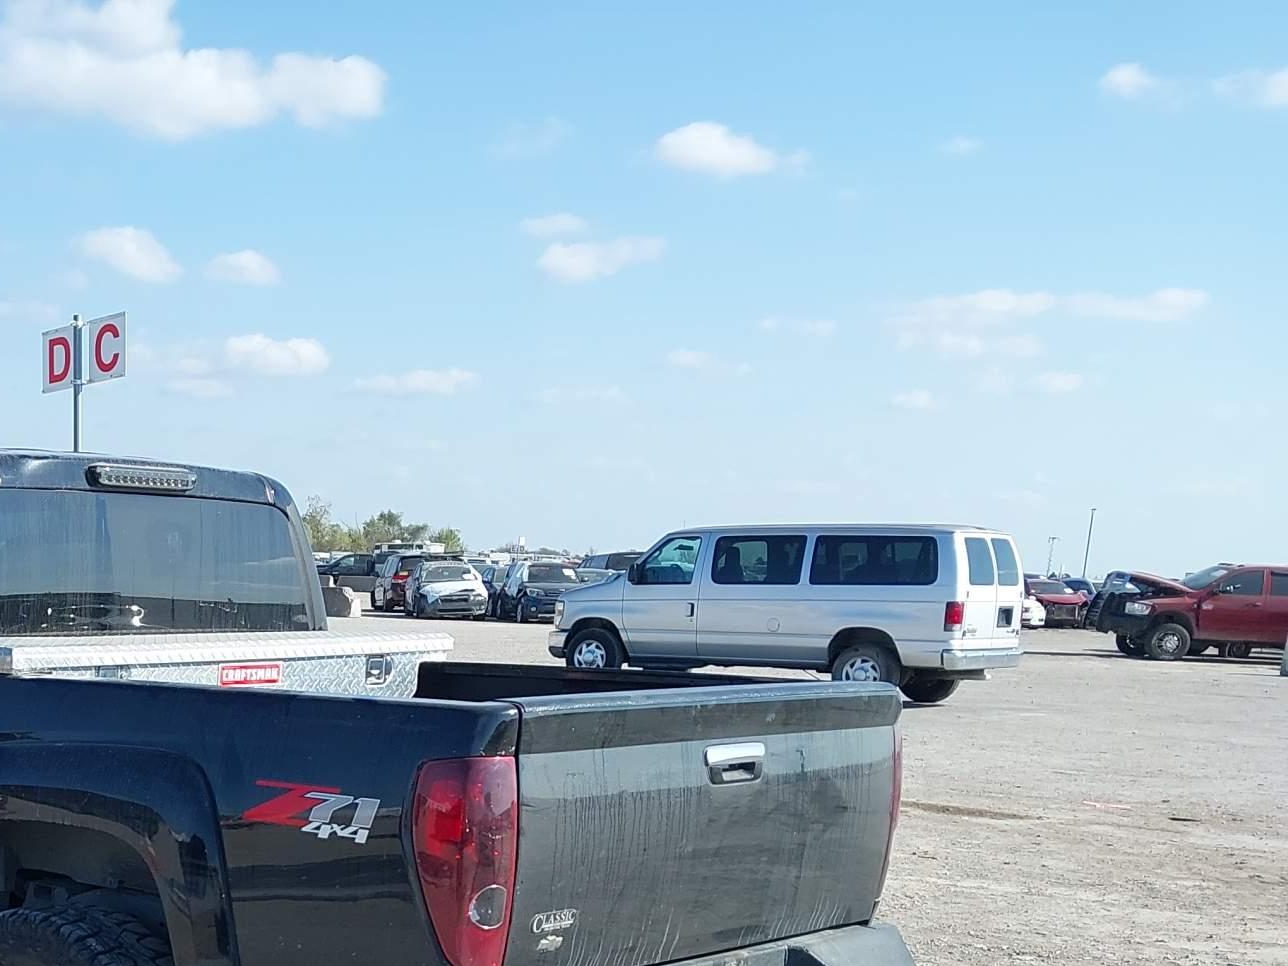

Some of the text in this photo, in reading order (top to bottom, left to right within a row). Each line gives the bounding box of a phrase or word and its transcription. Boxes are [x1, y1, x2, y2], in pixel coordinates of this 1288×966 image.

[48, 336, 71, 384] D
[95, 323, 120, 373] C
[222, 666, 280, 682] CRAFTSMAN
[242, 779, 381, 829] Z71
